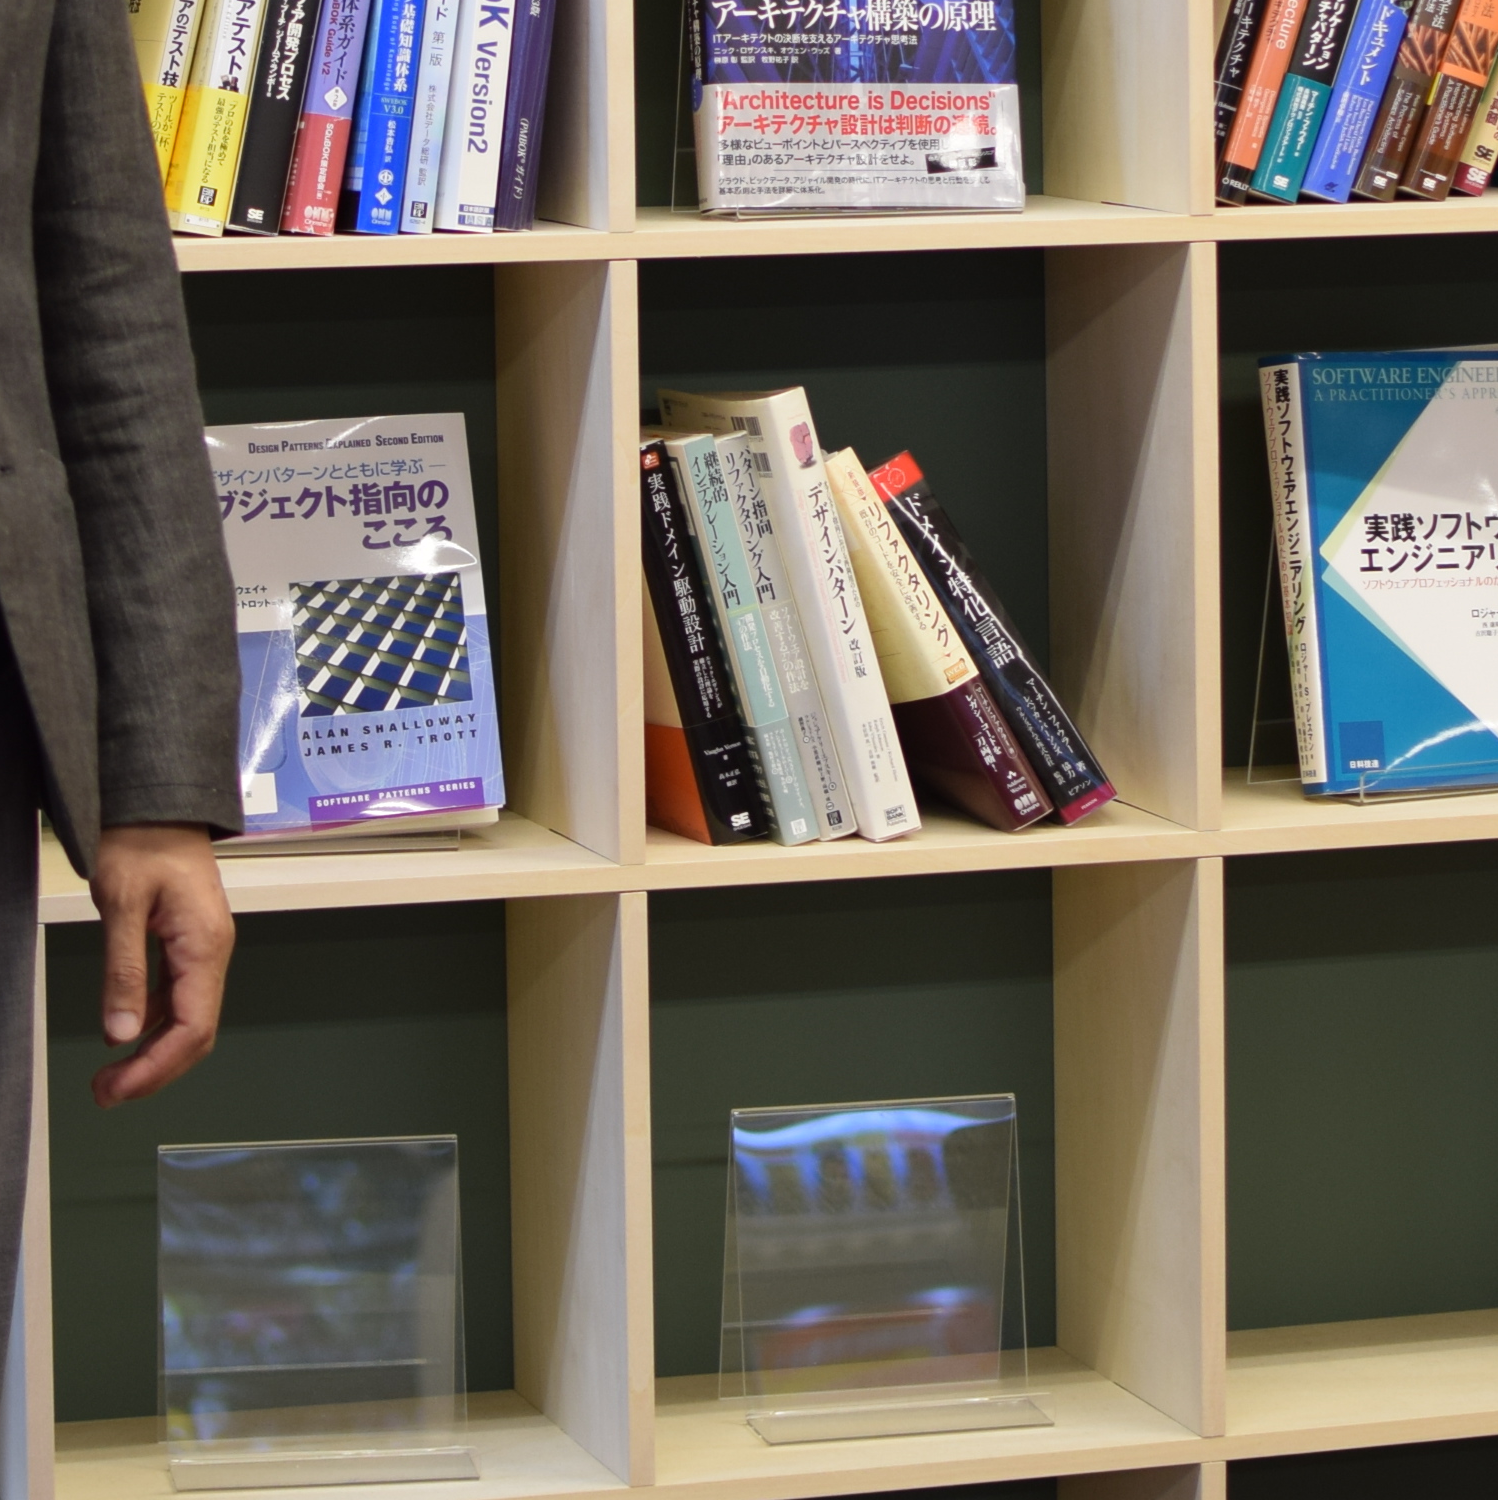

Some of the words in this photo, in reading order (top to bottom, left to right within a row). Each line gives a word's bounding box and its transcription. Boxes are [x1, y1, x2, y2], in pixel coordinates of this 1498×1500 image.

[324, 28, 336, 58] Guide
[429, 31, 446, 67] 第一版
[712, 34, 918, 45] ITアーキテクトの決断を支えるアーキテクチャ思考法
[1359, 5, 1395, 86] ドキュメント
[383, 105, 404, 115] V3.0
[467, 41, 498, 155] Version2
[867, 91, 884, 110] is
[1312, 368, 1411, 387] SOFTWARE
[1314, 390, 1323, 402] A
[1329, 387, 1456, 401] PRACTITIONER'S
[704, 451, 728, 503] 継続的
[739, 445, 773, 538] パターン指向
[1273, 369, 1308, 635] 実践ソフトウェアエンジニアリング
[361, 516, 453, 550] こころ
[691, 456, 740, 608] インテグレーション入門
[725, 452, 776, 604] リファクタリング入門
[647, 473, 706, 654] 実践ドメイン駆動設計
[808, 483, 856, 635] デザインパターン
[849, 638, 867, 678] 改訂版
[867, 501, 950, 647] リファクタリング
[905, 494, 1015, 669] ドメイン特化言語
[1300, 643, 1309, 684] ロジャー
[302, 725, 350, 741] ALAN
[362, 713, 478, 735] SHALLOWAY
[304, 741, 370, 757] JAMES
[383, 738, 403, 750] R.
[416, 728, 479, 746] TROTT
[1076, 761, 1087, 772] 著
[1349, 758, 1381, 770] 日科技連
[316, 793, 371, 808] SOFTWARE
[378, 786, 431, 800] PATTERNS
[439, 780, 477, 794] SERIES
[886, 805, 904, 815] SOFT
[887, 812, 906, 821] BANK
